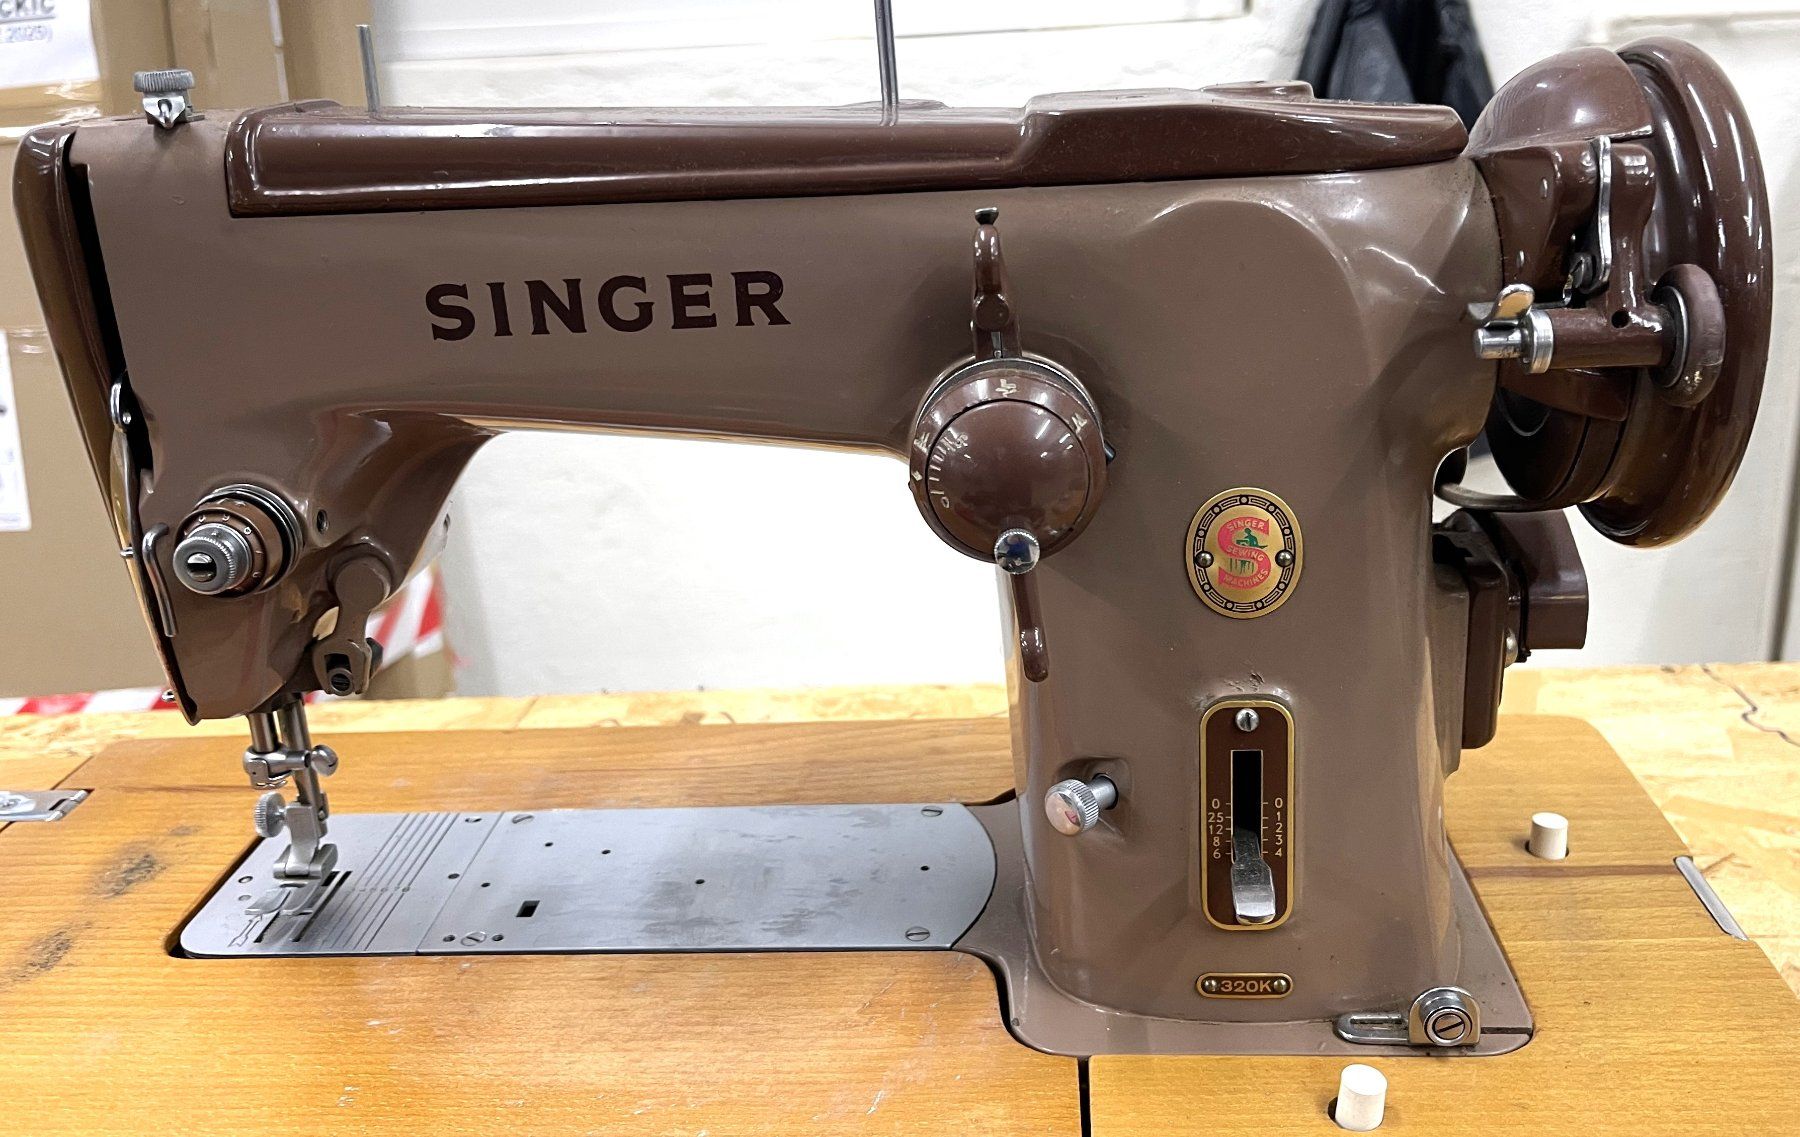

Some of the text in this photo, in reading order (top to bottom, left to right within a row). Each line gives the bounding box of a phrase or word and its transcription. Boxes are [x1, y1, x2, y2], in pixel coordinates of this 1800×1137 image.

[425, 270, 791, 341] SINGER
[1226, 520, 1265, 531] SINGER
[1226, 545, 1265, 561] SEWING
[1224, 569, 1269, 586] MACHINES
[1211, 798, 1220, 809] 0
[1274, 797, 1283, 809] 0
[1207, 812, 1224, 823] 25
[1276, 811, 1281, 821] 1
[1208, 824, 1223, 835] 12
[1275, 822, 1283, 833] 2
[1212, 836, 1220, 847] 8
[1275, 834, 1283, 845] 3
[1212, 848, 1221, 859] 6
[1274, 847, 1282, 857] 4
[1220, 980, 1272, 993] 320K
